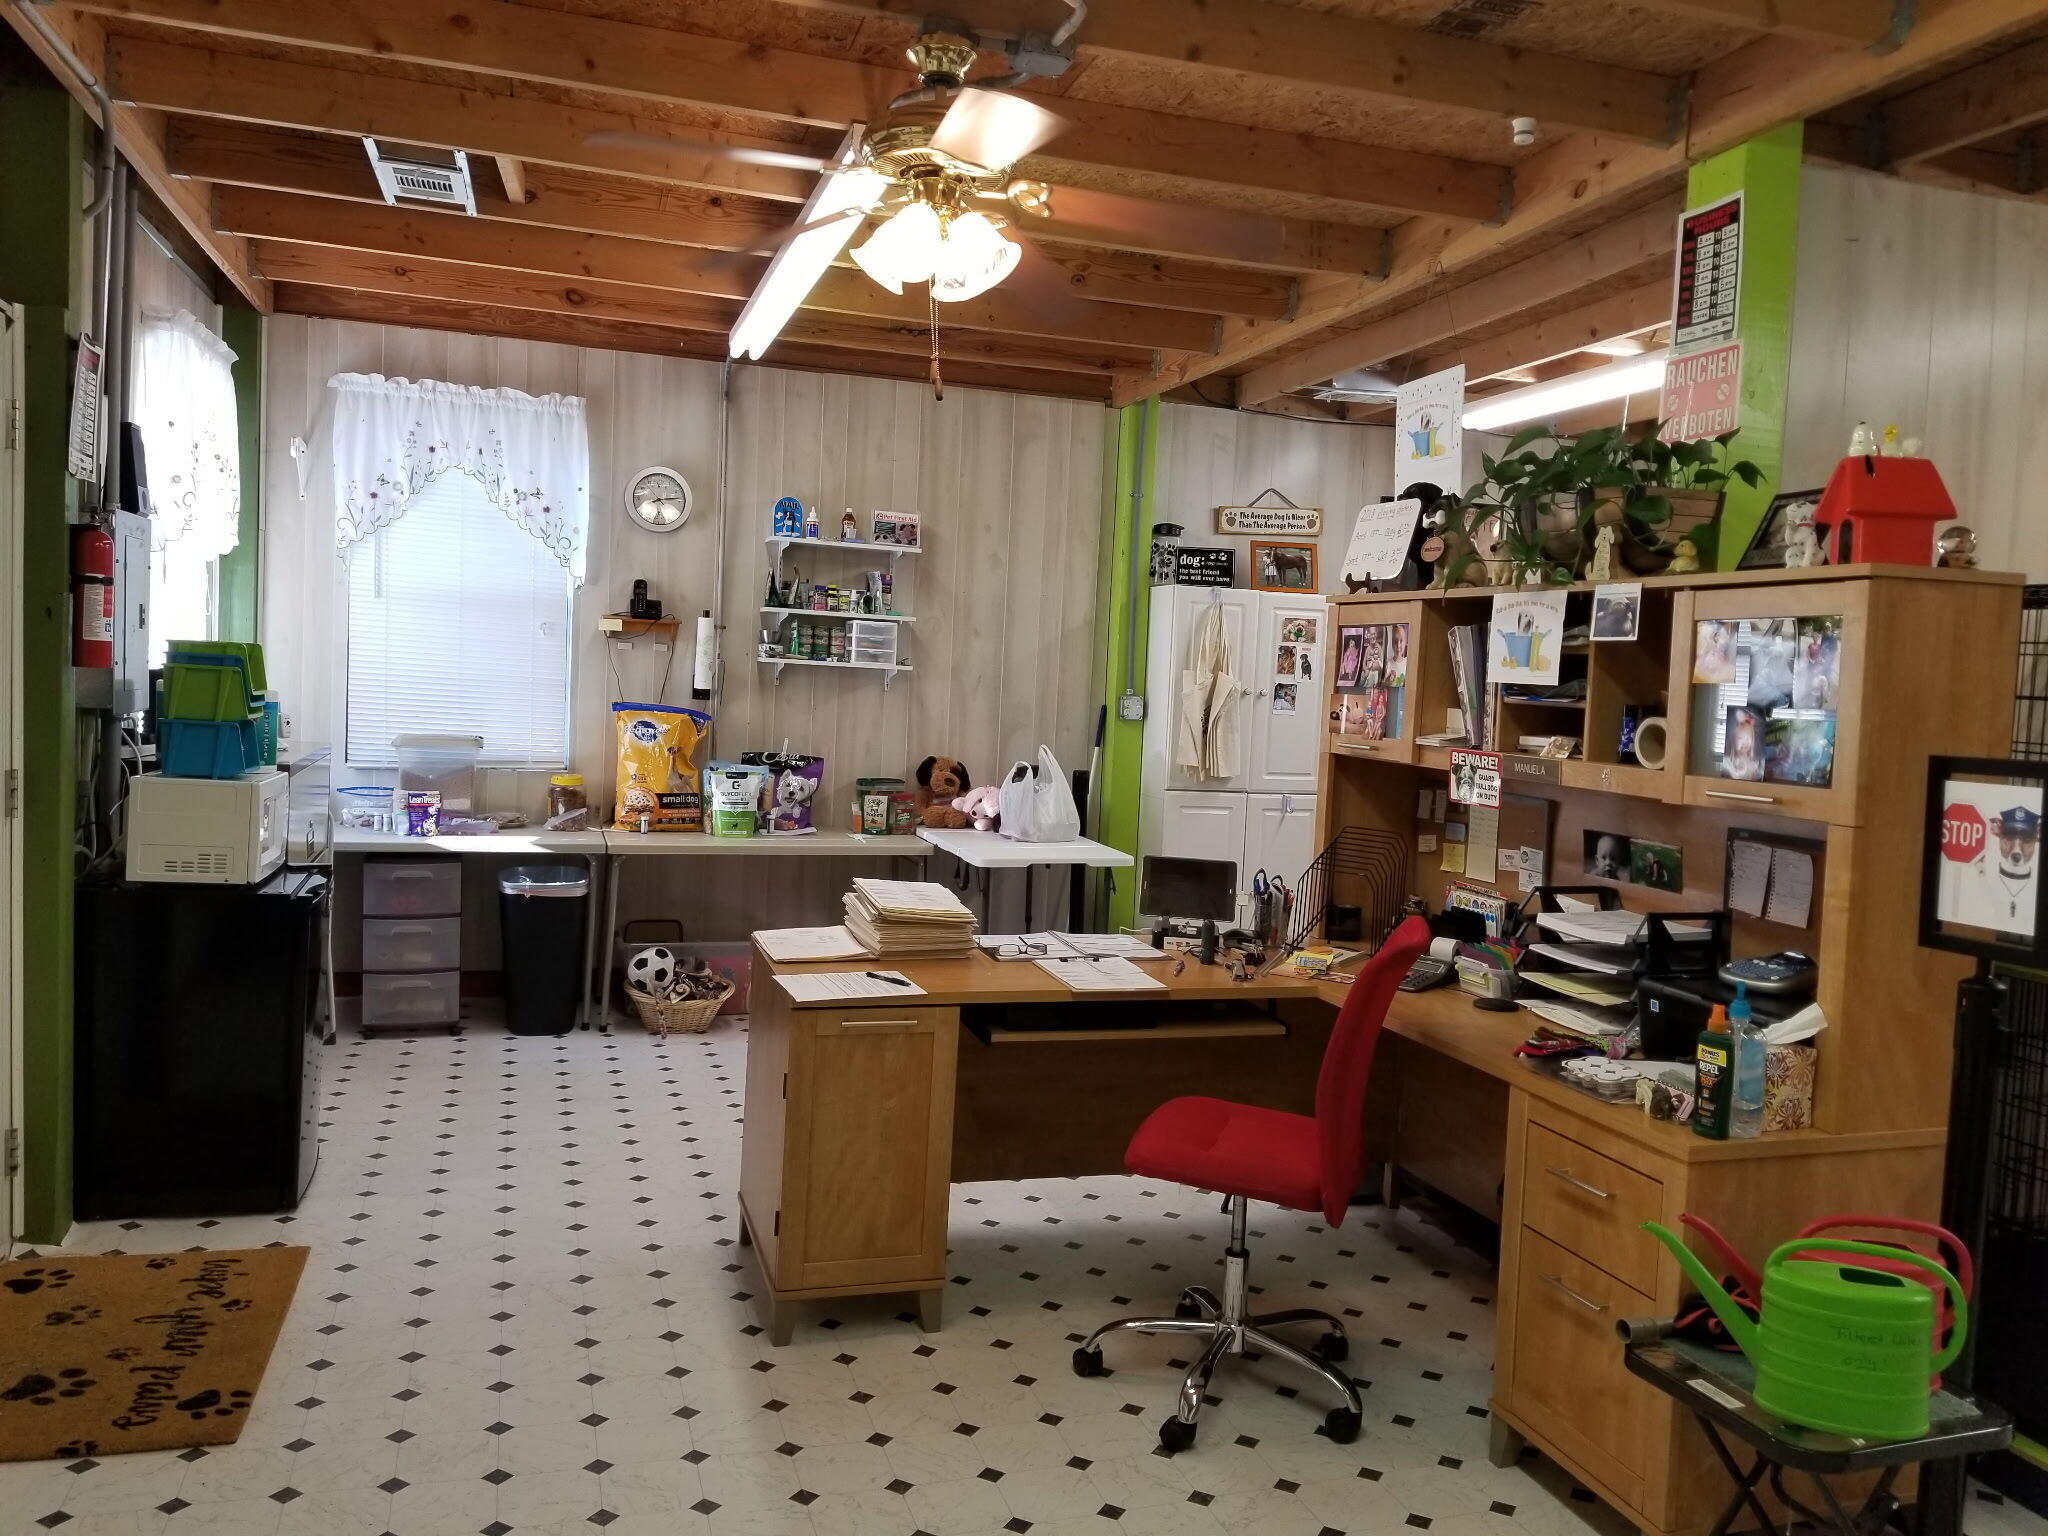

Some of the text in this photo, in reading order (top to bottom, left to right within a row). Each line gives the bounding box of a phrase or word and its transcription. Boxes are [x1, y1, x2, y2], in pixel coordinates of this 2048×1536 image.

[1666, 348, 1738, 390] RAUCHEN
[1664, 407, 1732, 440] VERBOTEN
[780, 501, 800, 510] MAIL
[1240, 512, 1249, 520] The
[1250, 512, 1273, 521] Average
[1274, 513, 1285, 521] Dog
[1238, 521, 1252, 529] Than
[1253, 521, 1263, 529] The
[1263, 521, 1286, 530] Average
[1180, 554, 1205, 568] dog:
[1452, 751, 1499, 770] BEWARE!
[1514, 762, 1546, 775] MANUELA
[1479, 773, 1495, 782] GUARD
[1475, 782, 1498, 793] BULLDOG
[662, 795, 699, 804] small dog
[1483, 792, 1498, 802] DUTY
[1941, 819, 1983, 847] STOP
[1699, 1060, 1719, 1075] REPEL
[133, 1307, 217, 1357] your
[112, 1365, 187, 1431] paws
